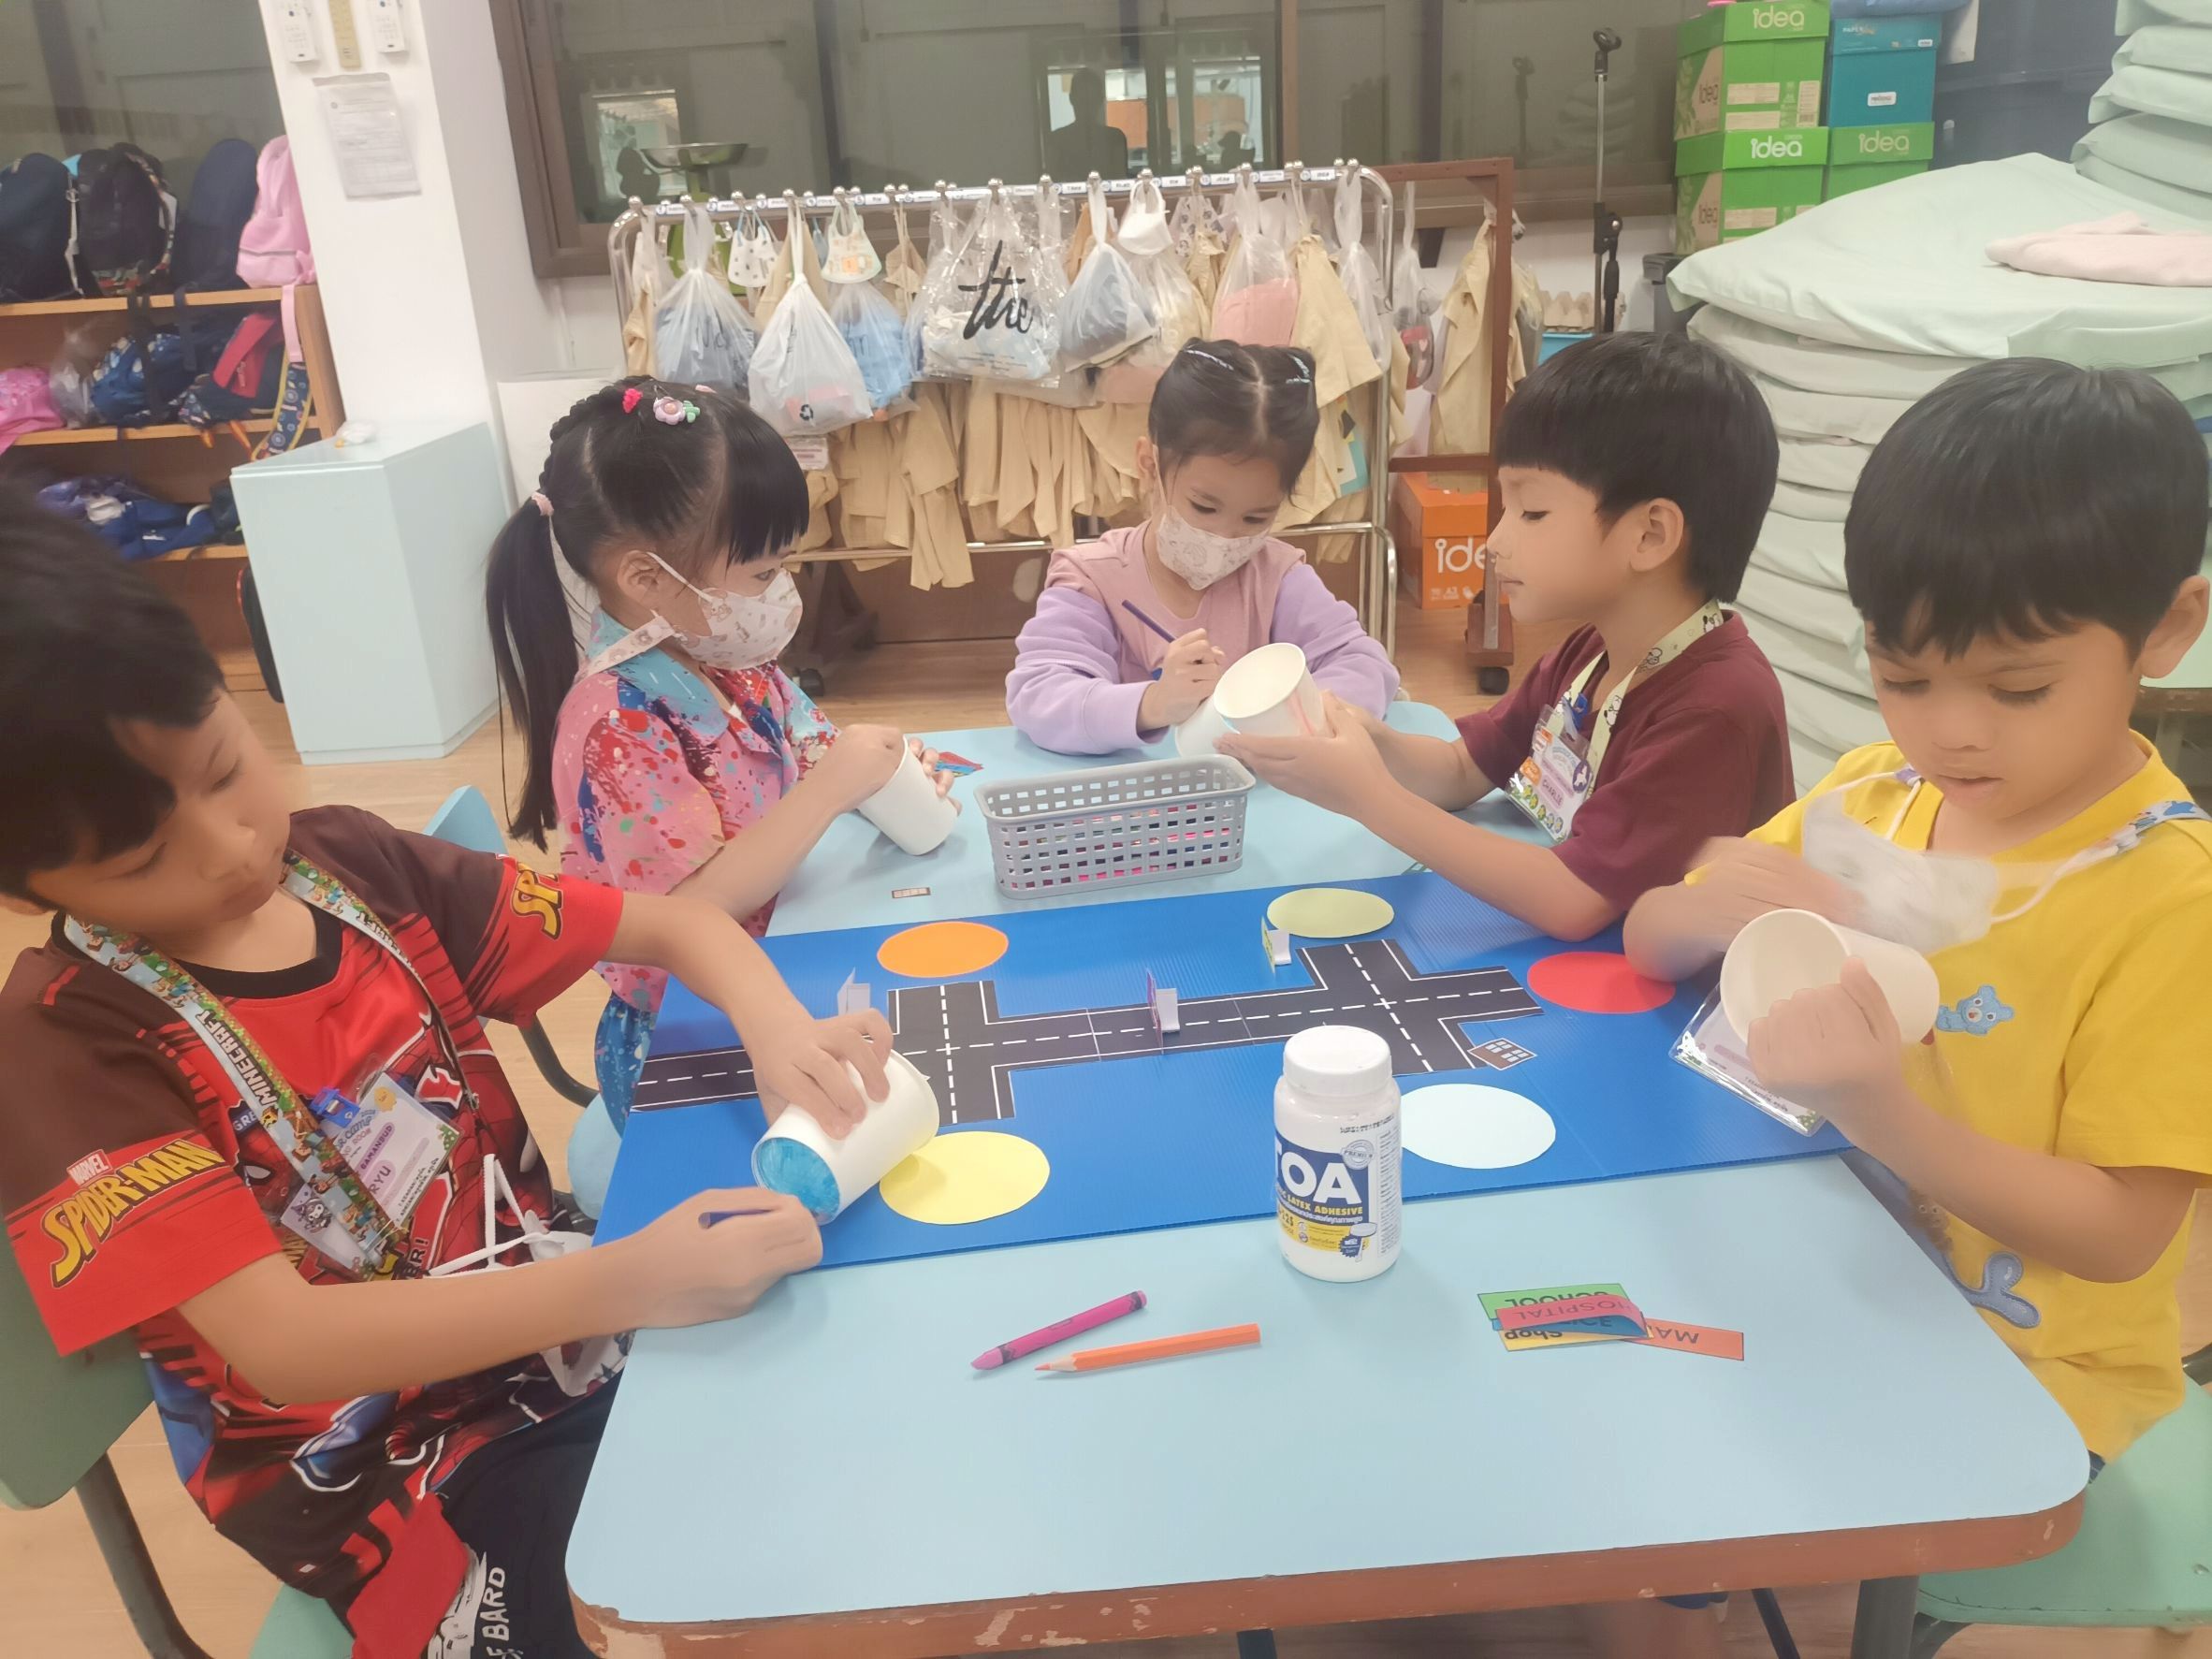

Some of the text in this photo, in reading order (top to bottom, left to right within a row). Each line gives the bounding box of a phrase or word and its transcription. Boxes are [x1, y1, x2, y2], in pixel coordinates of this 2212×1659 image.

[1753, 6, 1805, 30] idea
[1751, 135, 1803, 159] idea
[1858, 130, 1910, 154] idea
[1434, 536, 1486, 574] ide
[196, 1010, 280, 1107] MINECRAFT
[68, 1152, 110, 1186] MARVEL
[41, 1139, 230, 1289] SPIDER-MAN
[1287, 1193, 1311, 1212] LATEX
[1314, 1205, 1363, 1216] ADHESIVE
[1650, 1324, 1700, 1345] MA
[480, 1566, 510, 1642] BARD
